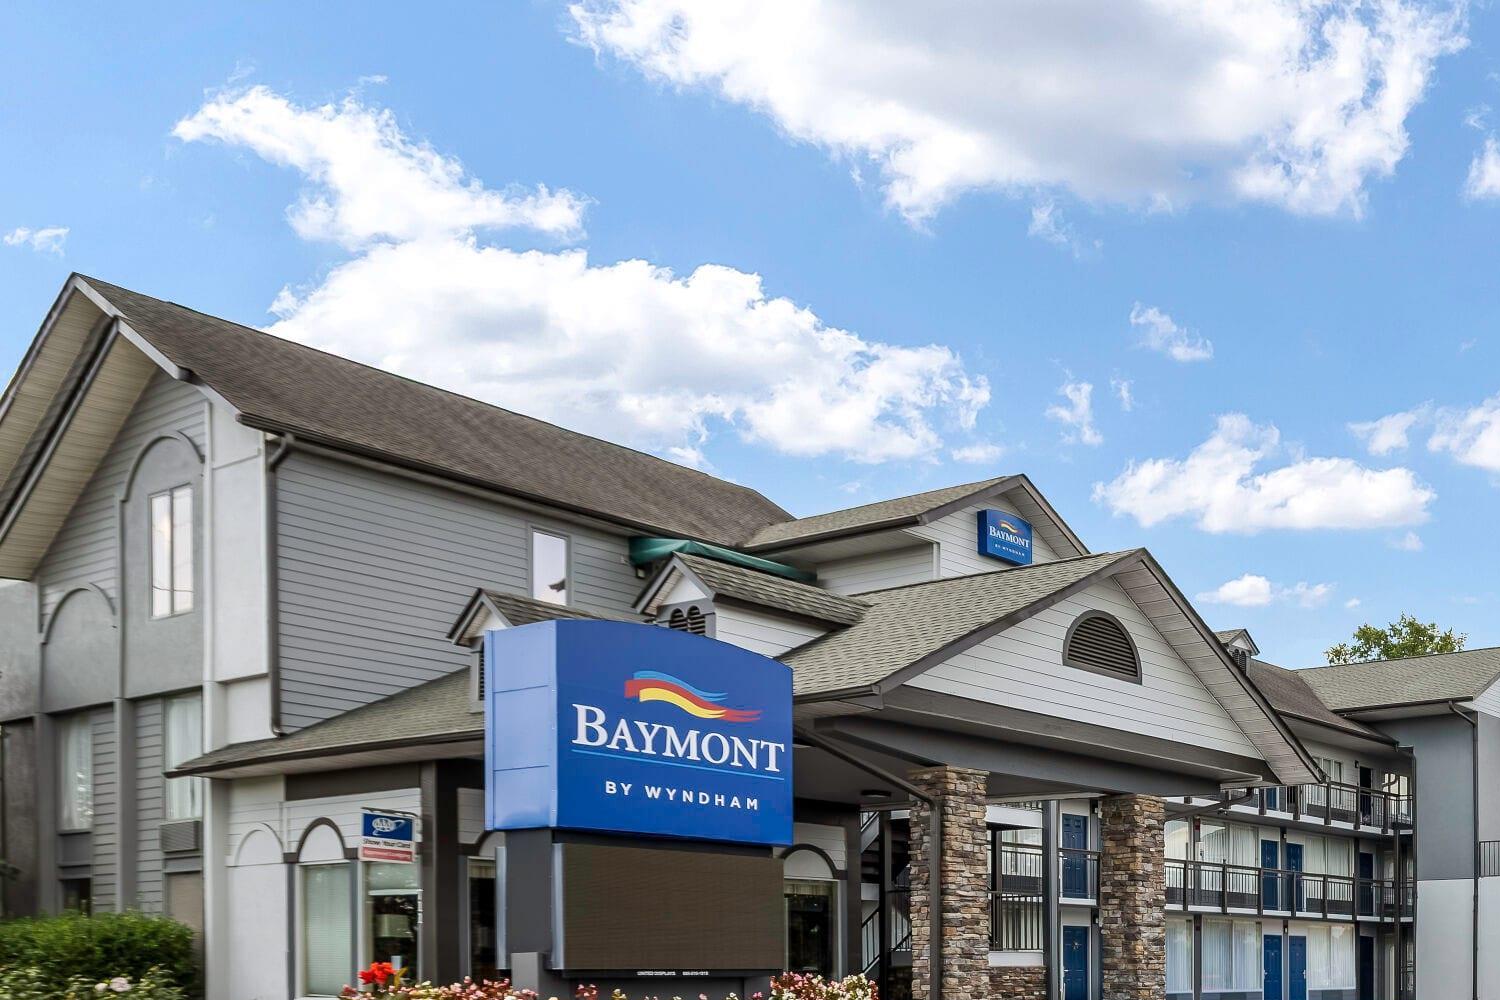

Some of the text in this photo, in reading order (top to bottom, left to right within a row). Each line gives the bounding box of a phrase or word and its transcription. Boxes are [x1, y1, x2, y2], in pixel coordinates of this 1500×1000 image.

[989, 526, 1030, 548] BAYMONT
[572, 703, 785, 772] BAYMONT
[605, 781, 758, 811] BY WYNDHAM
